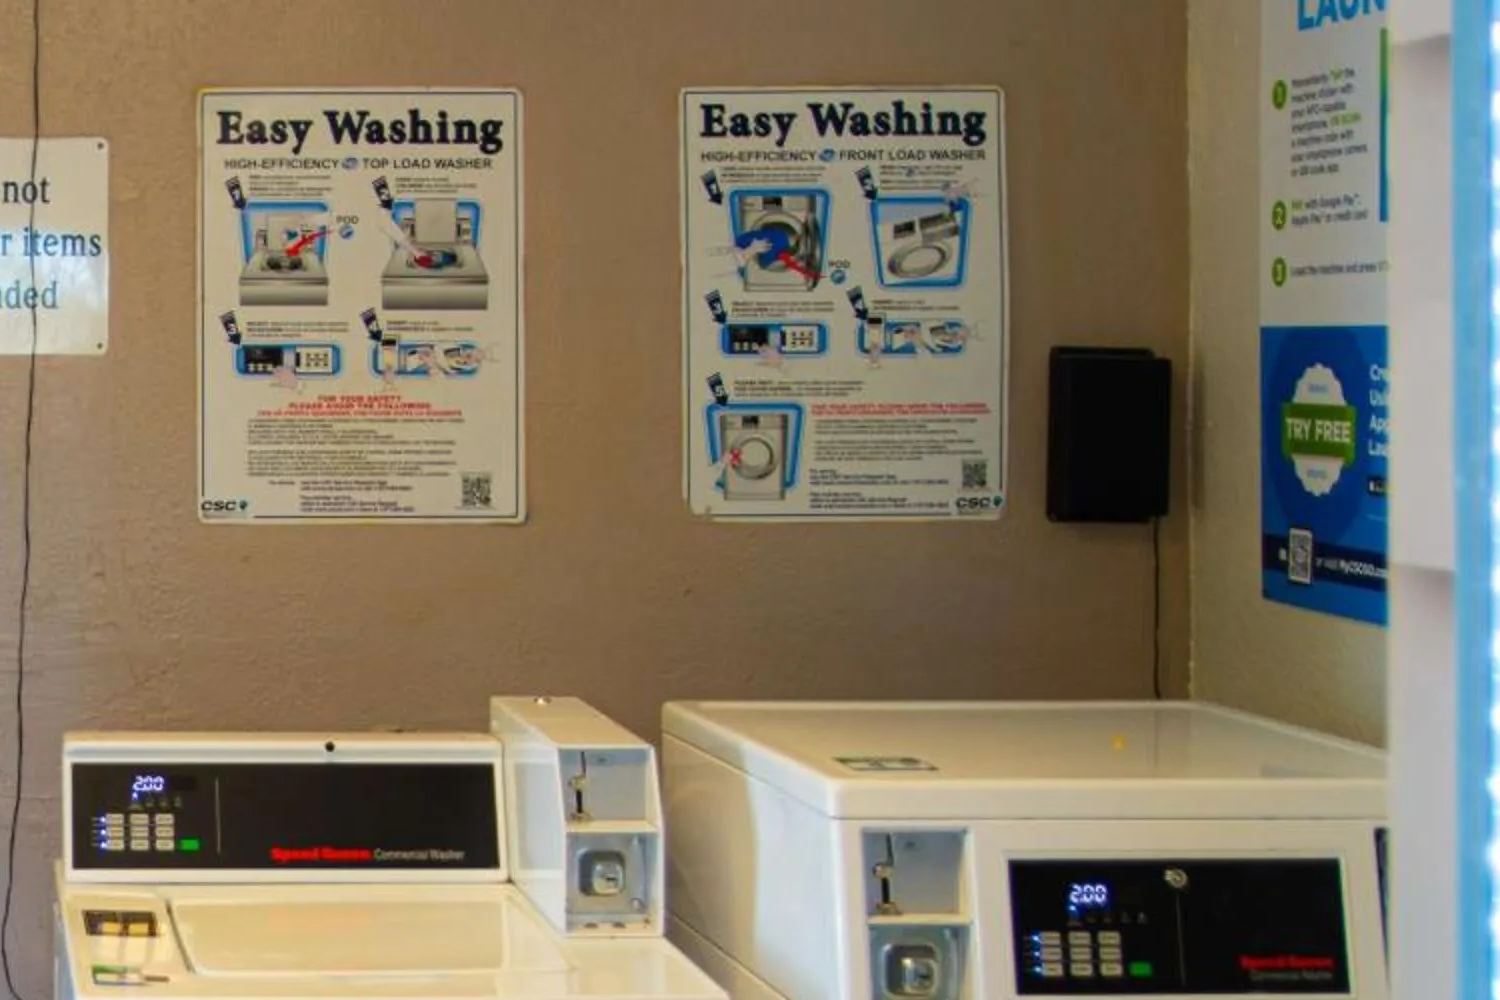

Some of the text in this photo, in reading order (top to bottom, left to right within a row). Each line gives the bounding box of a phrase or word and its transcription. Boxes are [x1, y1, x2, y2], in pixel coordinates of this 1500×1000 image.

[216, 108, 504, 154] Easy Washing
[700, 101, 988, 147] Easy Washing
[224, 158, 340, 170] HIGH-EFFICIENCY
[362, 158, 389, 170] TOP
[393, 158, 431, 170] LOAD
[434, 158, 493, 170] WASHER
[700, 150, 816, 162] HIGH-EFFICIENCY
[839, 150, 885, 162] FRONT
[888, 150, 926, 162] LOAD
[929, 150, 987, 161] WASHER
[2, 177, 51, 205] not
[23, 226, 102, 258] items
[1284, 417, 1352, 443] TRY FREE
[201, 500, 237, 512] CSC
[956, 497, 991, 509] CSC
